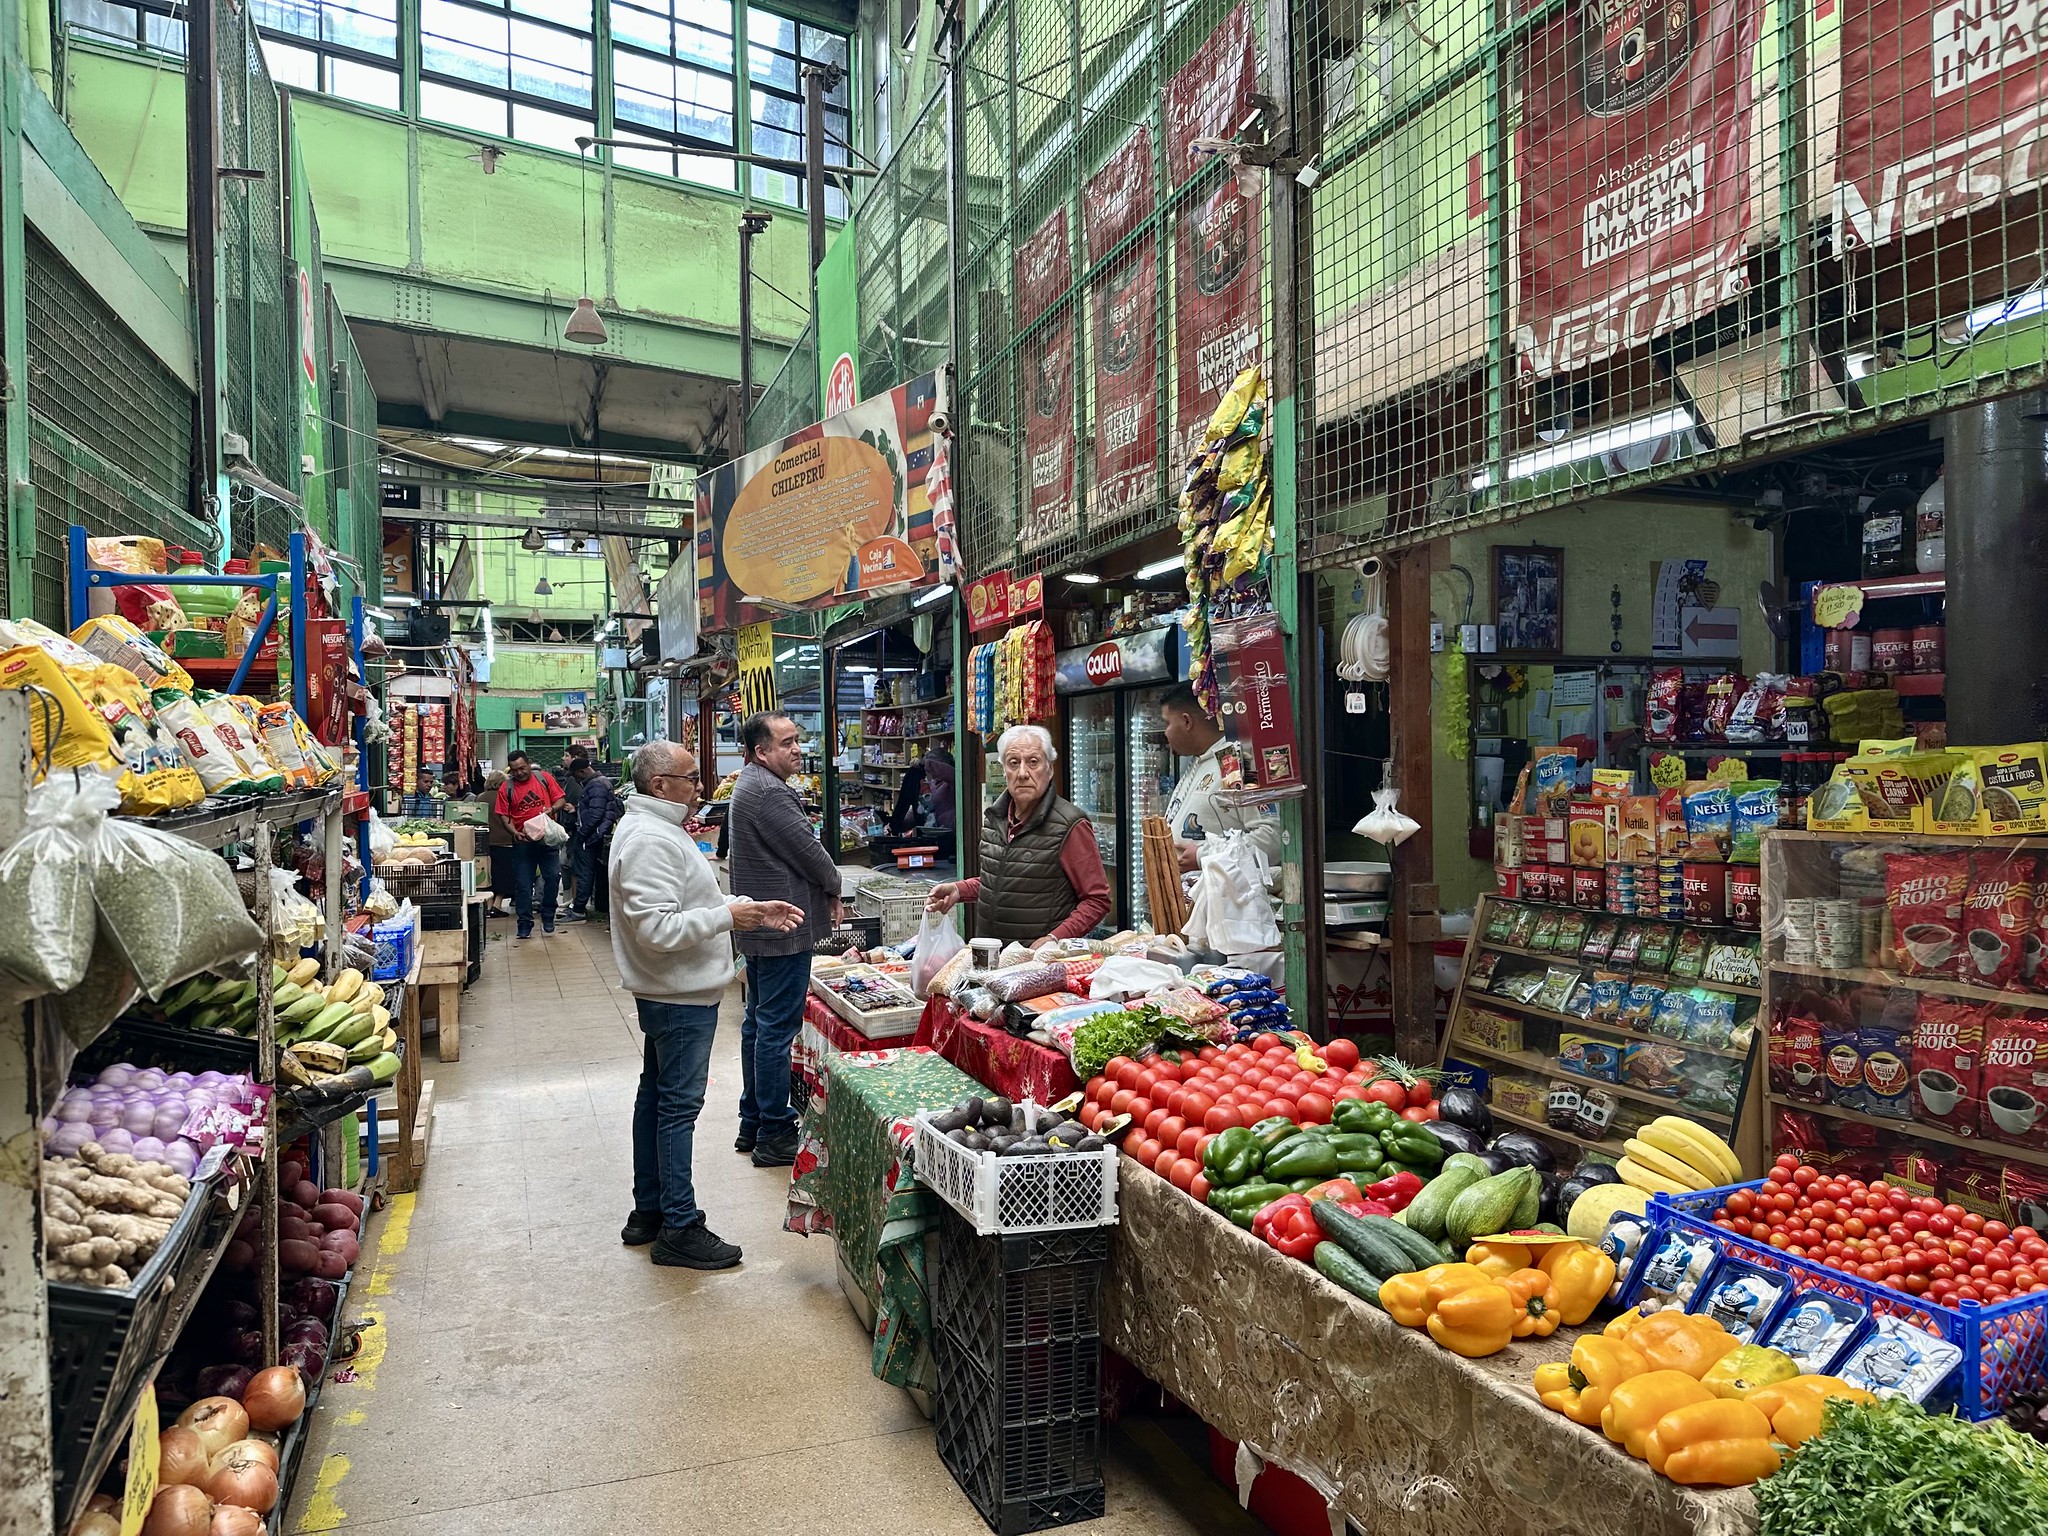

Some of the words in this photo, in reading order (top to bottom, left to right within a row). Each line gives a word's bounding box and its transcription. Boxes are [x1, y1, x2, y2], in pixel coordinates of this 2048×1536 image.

[1595, 151, 1654, 196] Ahora
[1659, 130, 1694, 162] con
[1595, 159, 1696, 228] NUEVA
[1588, 188, 1698, 261] IMAGEN
[1202, 328, 1247, 366] NUEVA
[1105, 408, 1138, 434] NUEVA
[774, 441, 821, 475] Comercial
[771, 459, 825, 498] CHILEPERÚ
[868, 549, 882, 562] Caja
[862, 561, 883, 574] Vecina
[739, 624, 762, 643] FRUTA
[738, 642, 771, 663] CONFITADA
[1086, 650, 1121, 676] COLUN
[1651, 679, 1673, 690] SELLO
[1650, 688, 1671, 700] ROJO
[1539, 765, 1563, 779] NESTEA
[1989, 773, 2015, 785] COSTILLA
[2015, 769, 2036, 781] FIDEOS
[1996, 767, 2008, 775] SOPA
[1570, 806, 1603, 816] Buñuelos
[1694, 803, 1731, 816] NESTE
[1624, 816, 1649, 829] Natilla
[1901, 875, 1950, 893] SELLO
[1977, 880, 2009, 896] SELLO
[1899, 888, 1948, 908] ROJO
[1971, 893, 2006, 910] ROJO
[1715, 961, 1752, 974] Deliciosa
[1598, 988, 1621, 997] NESTEA
[1630, 992, 1653, 1001] NESTEA
[1697, 1008, 1723, 1017] NESTEA
[1920, 1023, 1960, 1035] SELLO
[1794, 1041, 1812, 1050] ROJO
[1795, 1034, 1813, 1042] SELLO
[1918, 1035, 1958, 1051] ROJO
[1990, 1037, 2037, 1051] SELLO
[1987, 1051, 2034, 1068] ROJO
